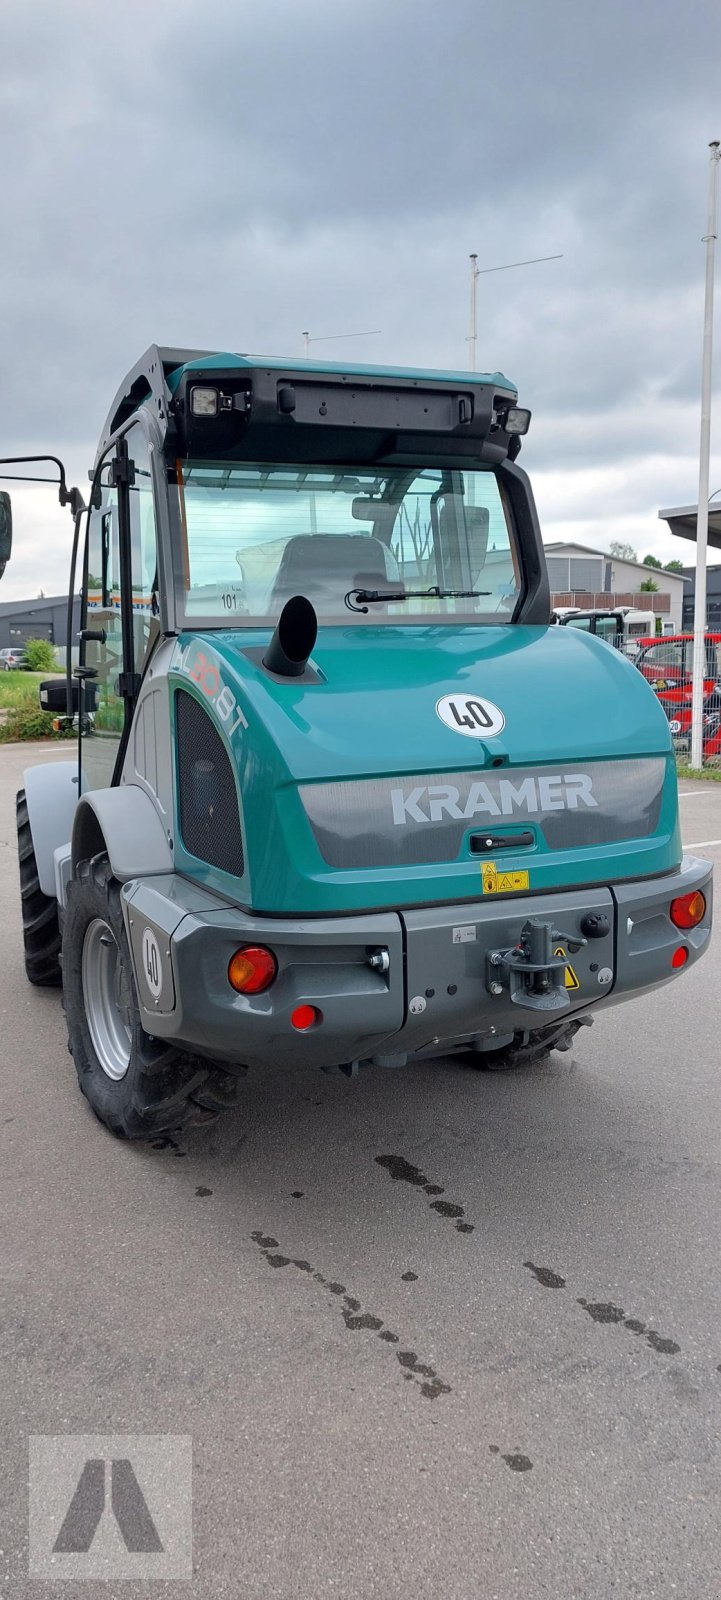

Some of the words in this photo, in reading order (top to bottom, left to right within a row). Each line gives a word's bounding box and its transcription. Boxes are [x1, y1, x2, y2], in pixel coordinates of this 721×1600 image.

[221, 593, 237, 609] 101
[448, 700, 494, 730] 40
[670, 721, 679, 730] 20
[390, 773, 599, 825] KRAMER
[146, 938, 159, 987] 40
